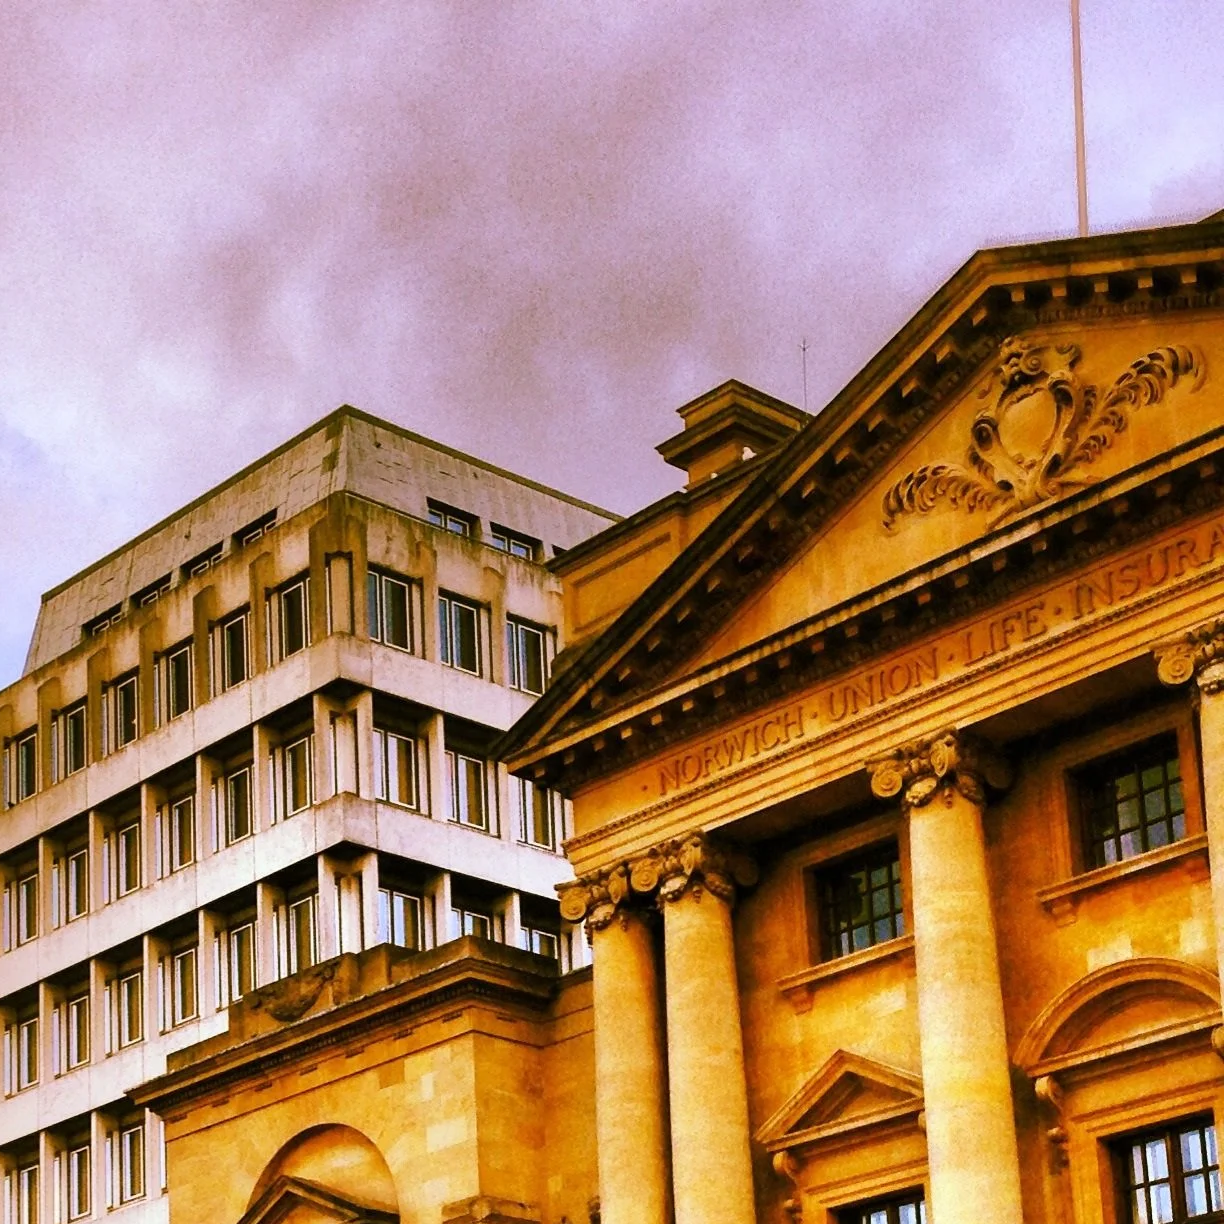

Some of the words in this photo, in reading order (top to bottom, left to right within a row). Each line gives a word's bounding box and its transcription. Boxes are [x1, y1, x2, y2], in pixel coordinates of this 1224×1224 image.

[657, 706, 805, 796] NORWICH
[828, 646, 940, 722] UNION
[963, 600, 1049, 667] LIFE
